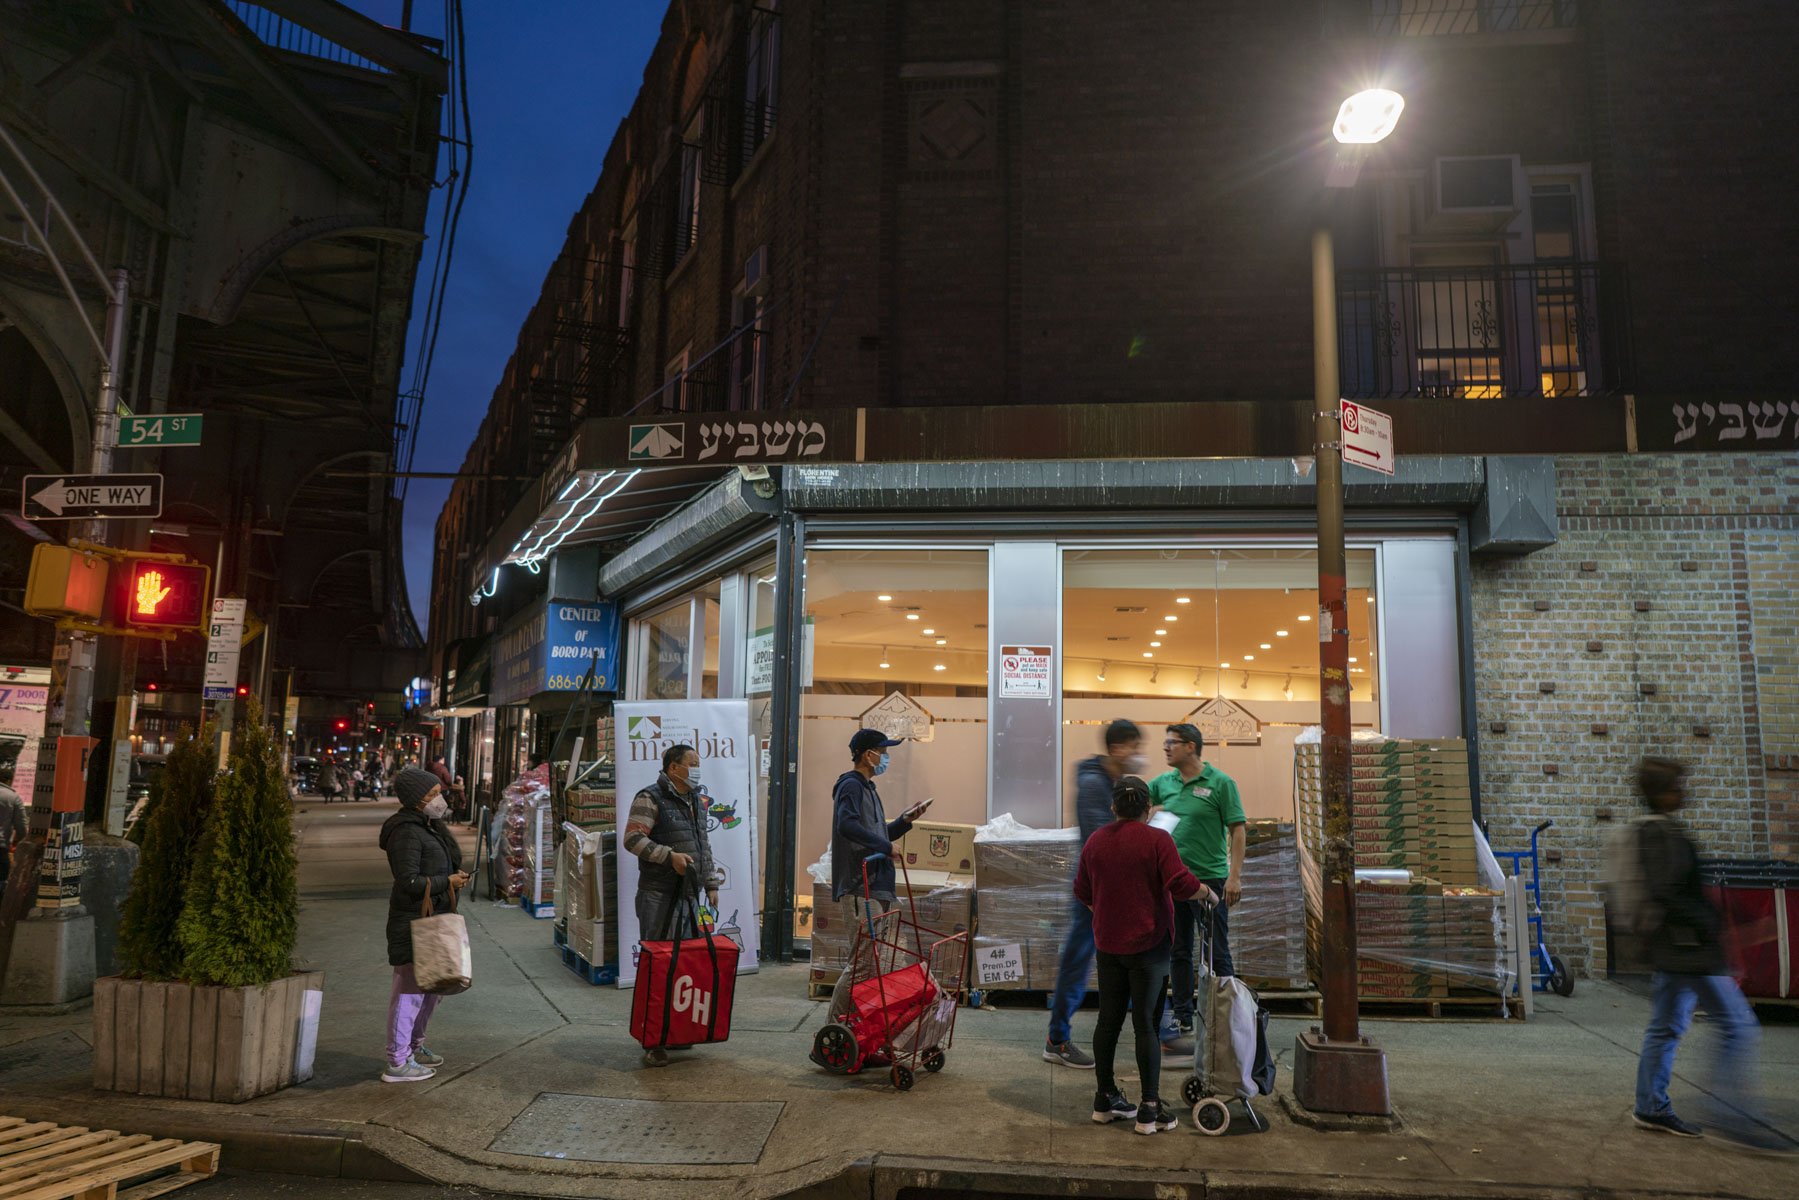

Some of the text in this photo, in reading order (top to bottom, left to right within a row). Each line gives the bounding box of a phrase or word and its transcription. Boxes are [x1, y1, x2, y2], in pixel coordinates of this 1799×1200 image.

[130, 418, 188, 443] 54 ST
[65, 487, 146, 505] ONE WAY
[559, 607, 601, 622] CENTER
[212, 626, 219, 635] 2
[575, 630, 588, 642] OF
[551, 645, 578, 658] BORO
[209, 653, 216, 663] 4
[17, 689, 46, 699] DOOR
[629, 728, 737, 761] mabia
[991, 949, 1006, 960] 4#
[982, 960, 1018, 970] Prem.DP
[984, 973, 1000, 982] EM
[673, 975, 711, 1026] GH
